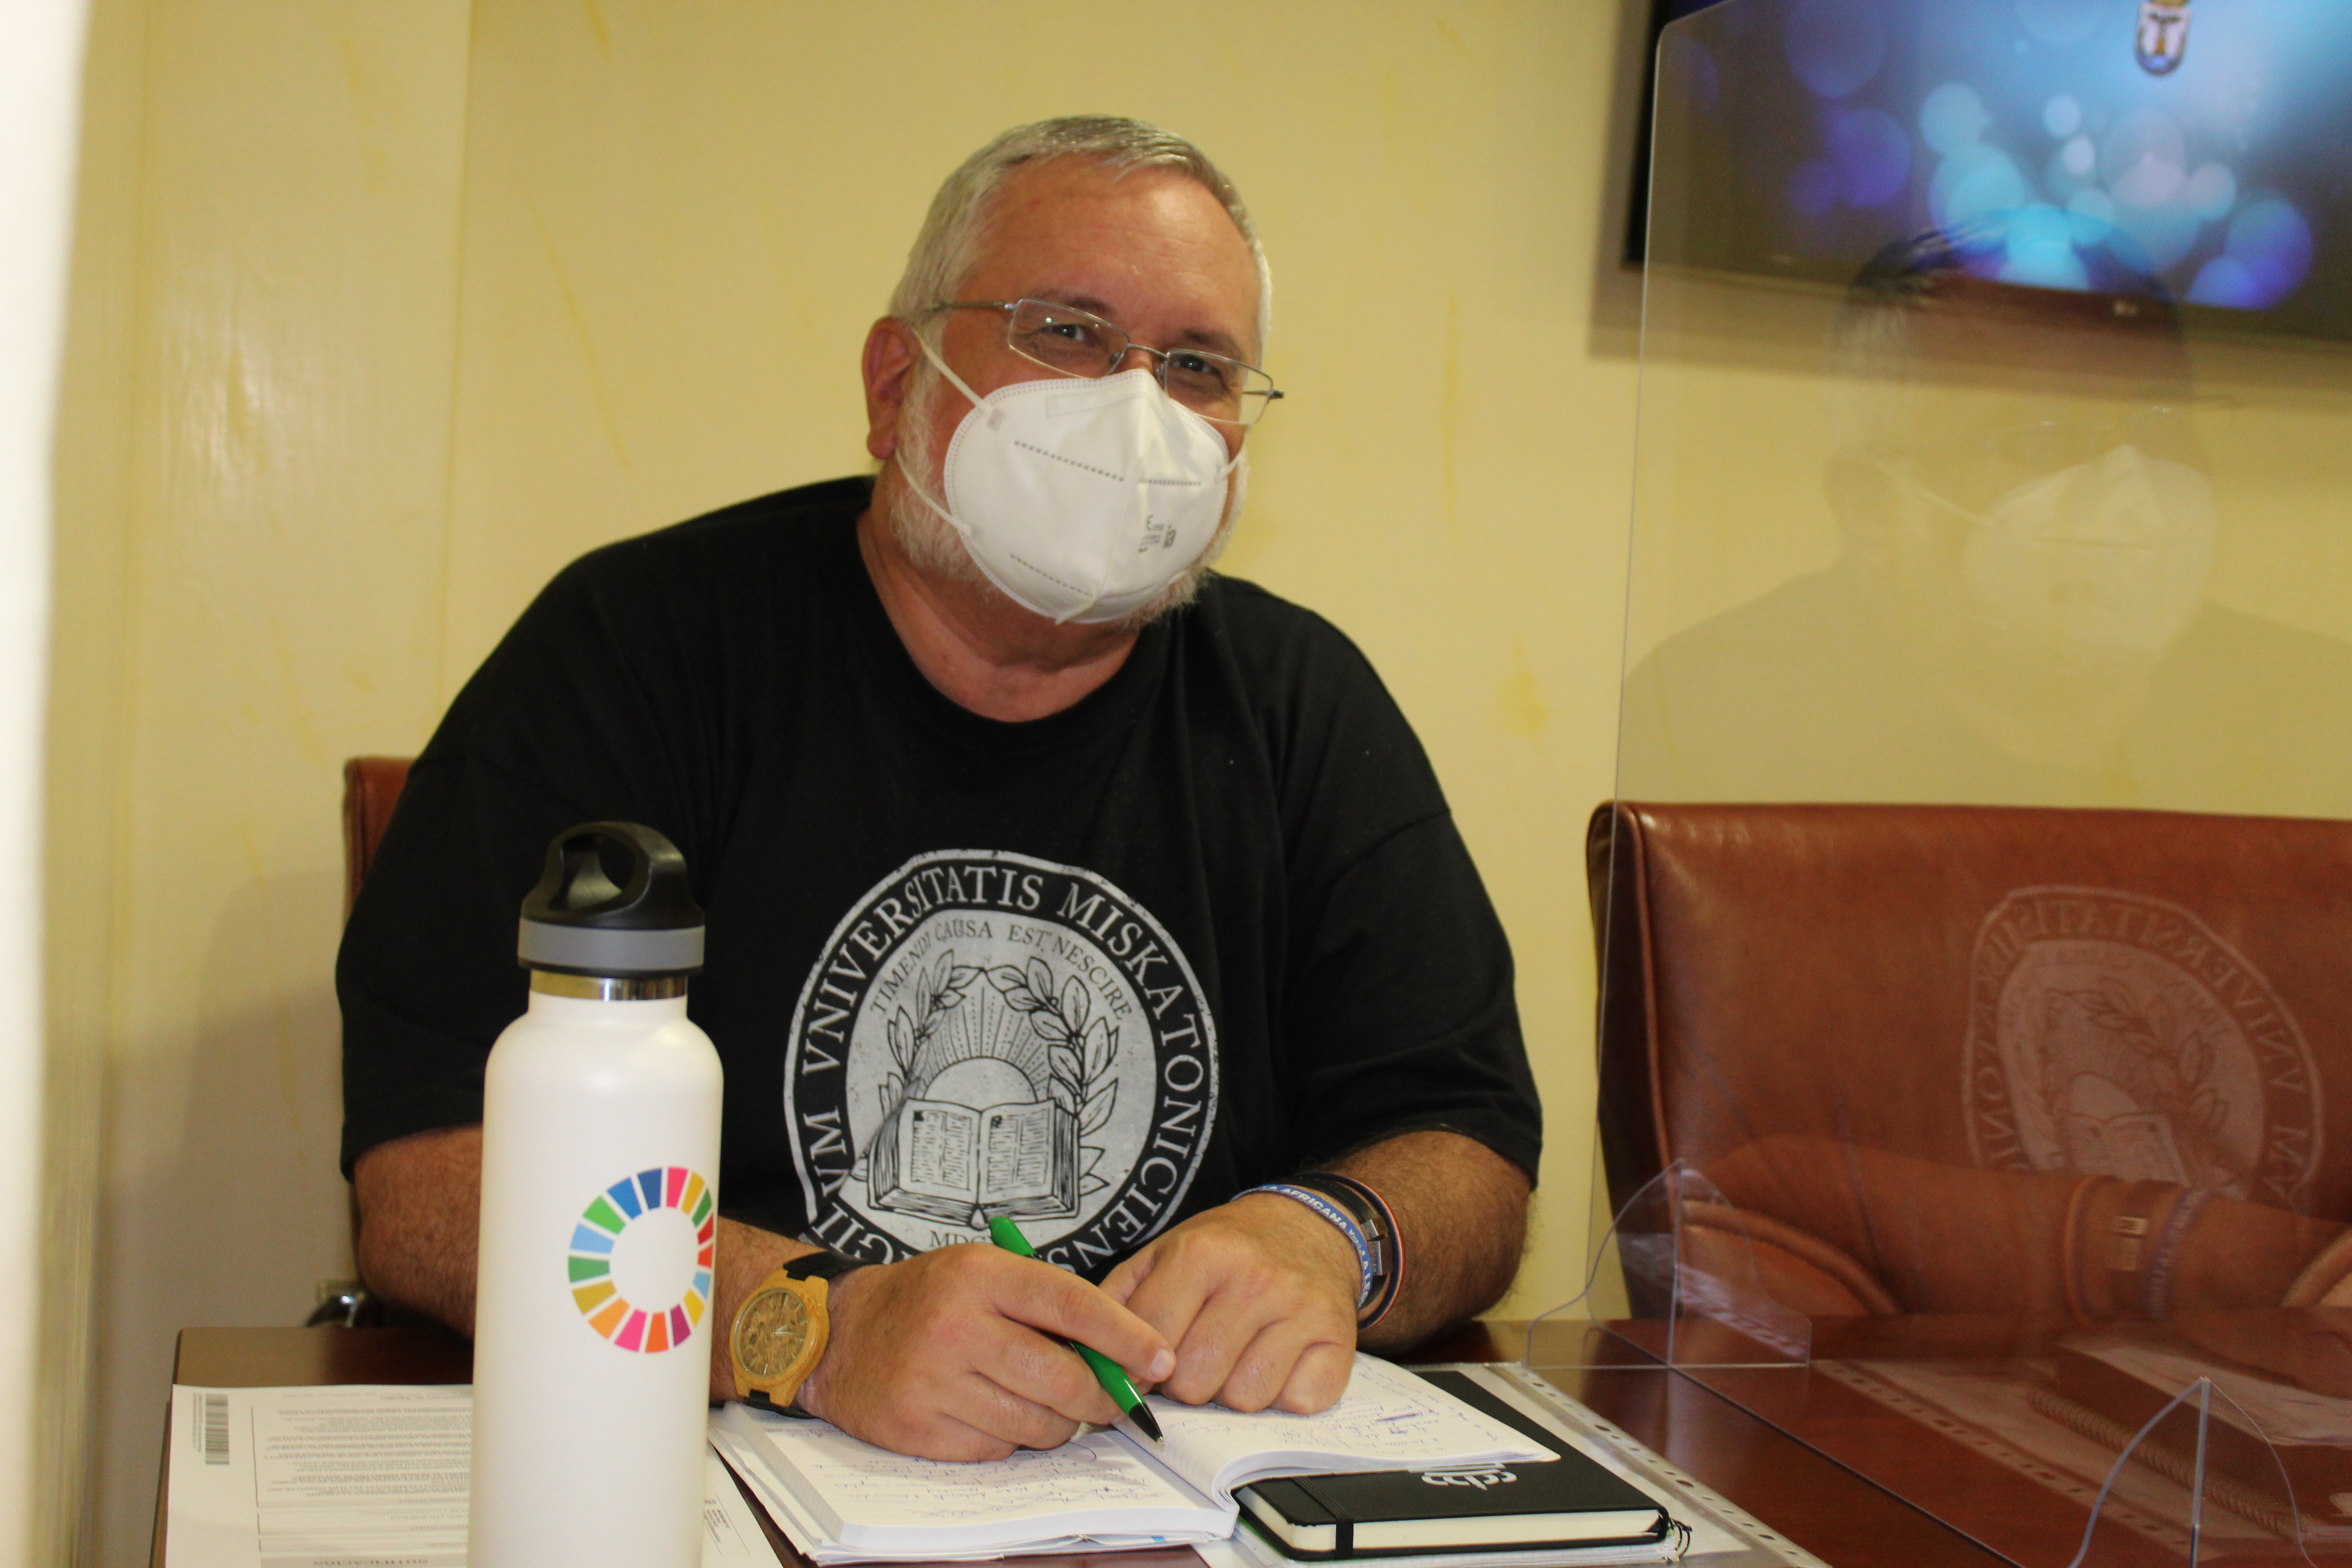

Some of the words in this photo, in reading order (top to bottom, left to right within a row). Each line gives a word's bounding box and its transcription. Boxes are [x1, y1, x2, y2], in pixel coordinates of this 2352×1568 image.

[802, 865, 1044, 1076] VNIVERSITATIS
[1046, 882, 1204, 1274] MISKATONICIENS
[935, 918, 992, 941] CAUSA
[1052, 935, 1132, 1020] NESCIRE
